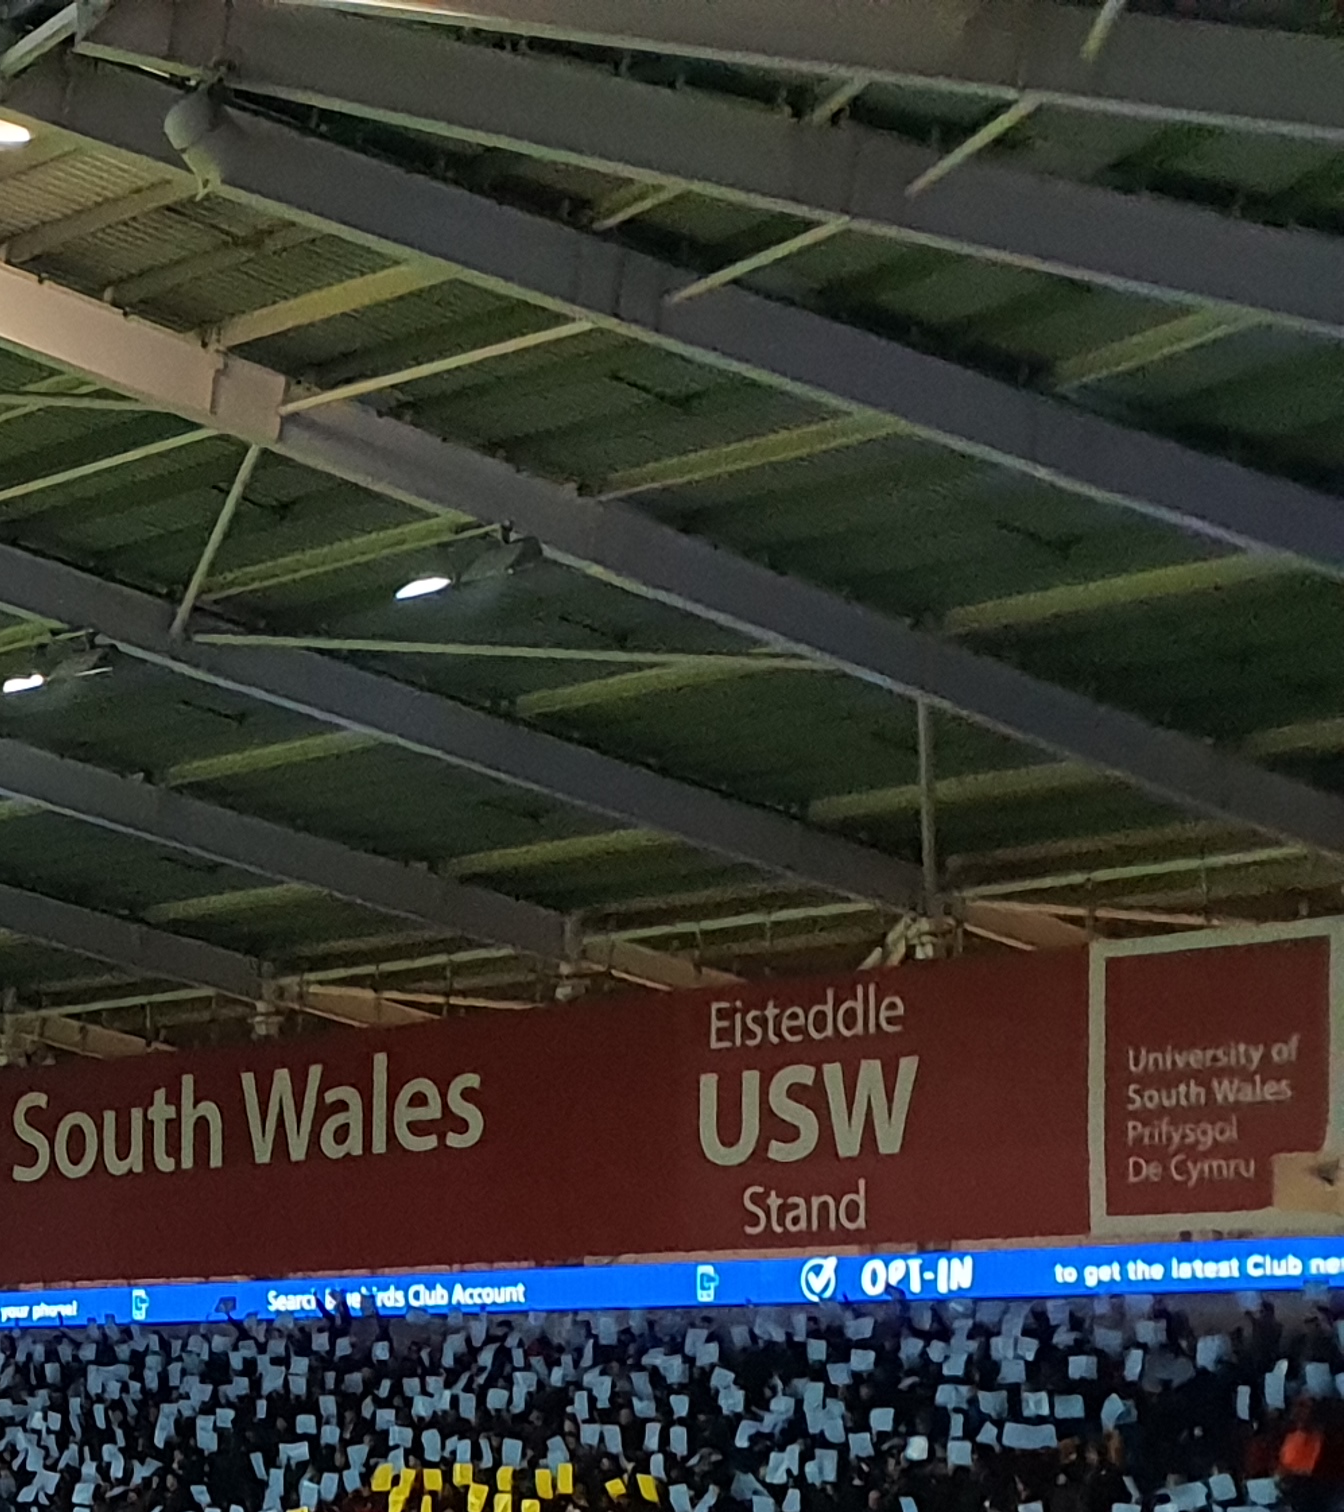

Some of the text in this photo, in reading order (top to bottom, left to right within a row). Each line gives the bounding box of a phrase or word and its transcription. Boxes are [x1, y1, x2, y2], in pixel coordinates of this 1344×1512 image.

[710, 982, 905, 1049] Eisteddle
[1128, 1033, 1300, 1072] University of
[699, 1055, 920, 1167] USW
[1127, 1074, 1293, 1111] South Wales
[12, 1073, 223, 1182] South
[240, 1051, 485, 1164] Wales
[1127, 1113, 1238, 1153] Prifysgol
[1128, 1154, 1255, 1187] De Cymru
[744, 1177, 866, 1235] Stand
[861, 1255, 973, 1297] OPT-IN
[1054, 1263, 1078, 1284] to
[1083, 1261, 1120, 1287] get
[1127, 1259, 1164, 1280] the
[1171, 1257, 1240, 1279] latest
[1246, 1254, 1303, 1276] Club
[267, 1287, 318, 1312] Searc
[408, 1282, 448, 1307] Club
[451, 1282, 526, 1306] Account
